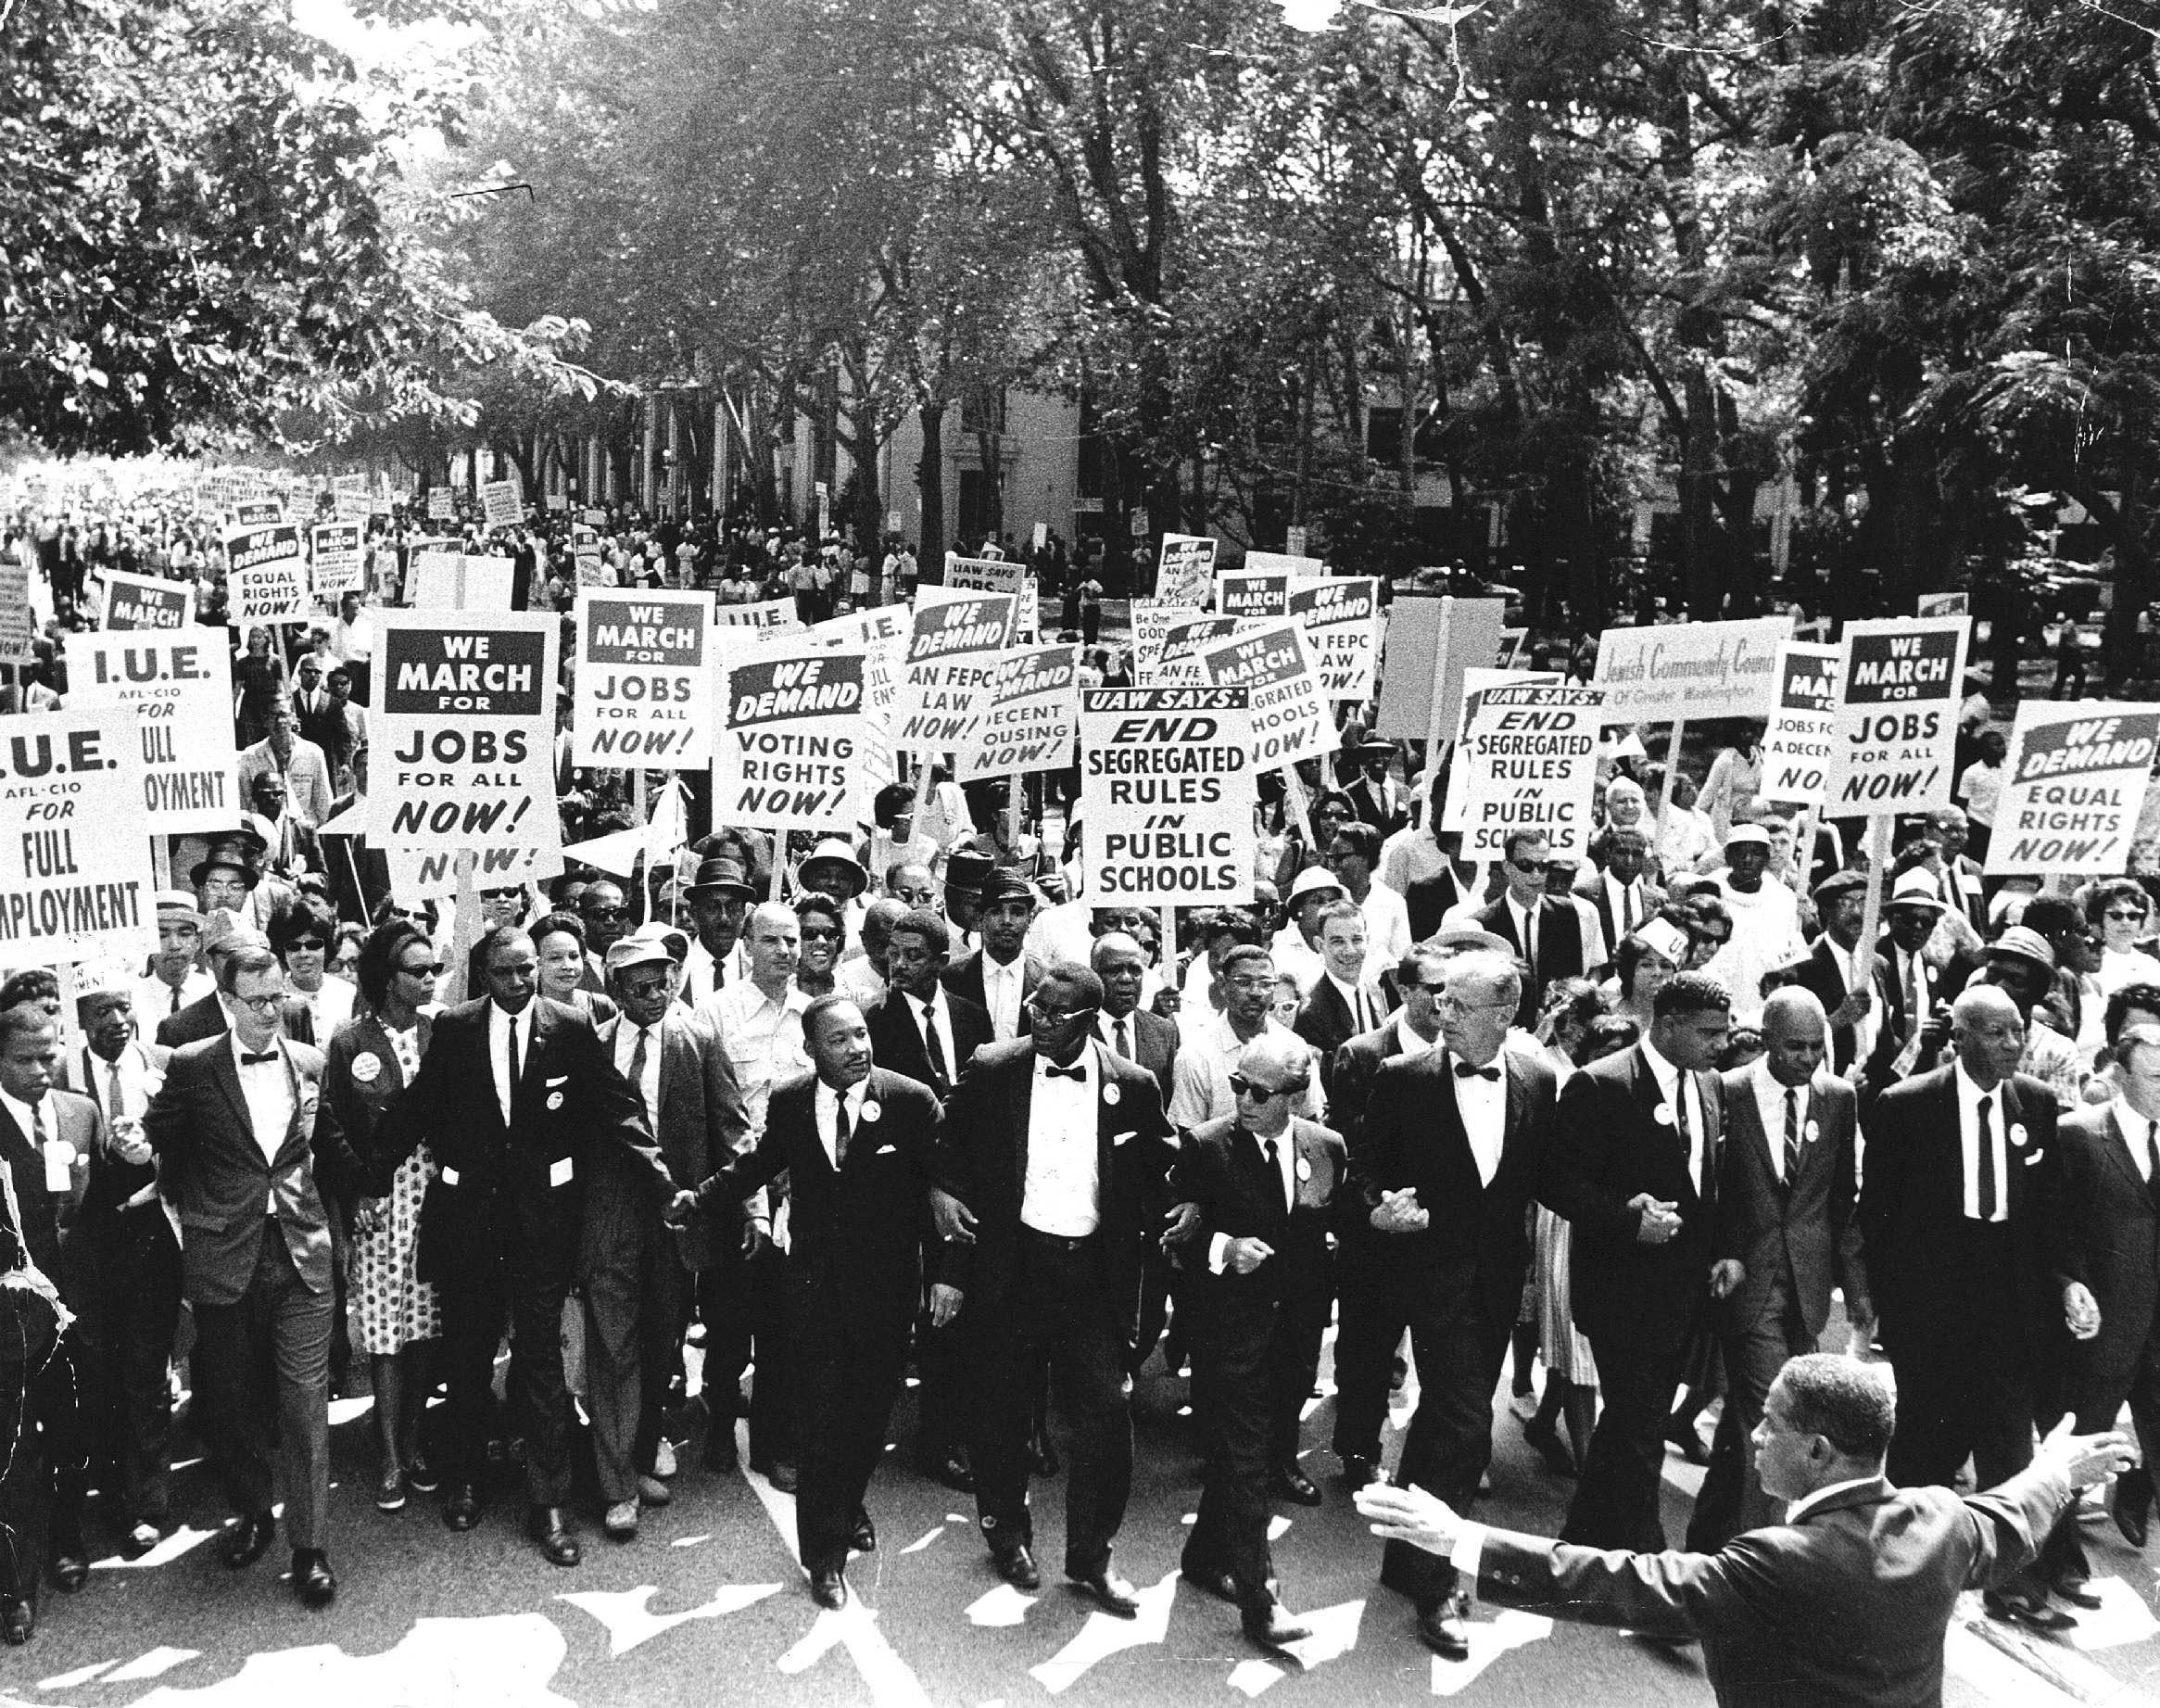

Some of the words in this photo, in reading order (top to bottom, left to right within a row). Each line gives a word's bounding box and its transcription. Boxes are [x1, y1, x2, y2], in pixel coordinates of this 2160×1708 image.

[249, 530, 276, 549] WE
[233, 538, 299, 570] DEMAND
[242, 571, 297, 586] EQUAL
[953, 563, 983, 575] UAW
[985, 567, 1016, 579] SAYS
[242, 586, 299, 601] RIGHTS
[319, 576, 357, 590] NOW!
[1245, 578, 1268, 591] WE
[140, 588, 165, 607] WE
[1226, 591, 1284, 608] MARCH
[1314, 585, 1347, 607] WE
[114, 601, 181, 627] MARCH
[243, 599, 301, 617] NOW!
[628, 605, 664, 625] WE
[943, 601, 982, 628] WE
[1244, 607, 1267, 616] FOR
[1305, 597, 1370, 627] EMAND
[595, 623, 695, 649] MARCH
[914, 620, 1003, 658] DEMAND
[1186, 622, 1217, 640] WE
[1307, 635, 1320, 650] N
[1326, 634, 1370, 649] FEPC
[0, 639, 28, 656] OW!
[443, 636, 490, 660] WE
[625, 650, 665, 664] FOR
[1235, 639, 1267, 660] WE
[1889, 636, 1923, 658] WE
[95, 645, 211, 684] I.U.E.
[998, 654, 1041, 682] WE
[1157, 664, 1181, 678] AN
[1185, 664, 1201, 678] FE
[1217, 646, 1297, 686] MARCH
[1320, 653, 1354, 667] AW
[1821, 659, 1839, 677] W
[1854, 656, 1949, 686] MARCH
[397, 661, 533, 693] MARCH
[771, 659, 825, 689] WE
[907, 665, 940, 687] AN
[945, 665, 994, 689] FEPC
[118, 688, 182, 700] AFL-CIO
[594, 675, 691, 702] JOBS
[1090, 690, 1156, 711] UAW
[1156, 688, 1246, 711] SAYS:
[1251, 678, 1313, 712] GRATED
[1485, 689, 1534, 705] UAW
[1882, 686, 1918, 701] FOR
[137, 702, 175, 718] FOR
[437, 695, 491, 711] FOR
[596, 706, 638, 719] FOR
[651, 707, 688, 720] ALL
[735, 681, 861, 722] DEMAND
[921, 691, 973, 712] LAW
[985, 703, 1063, 727] ECENT
[1251, 700, 1320, 734] HOOLS
[1496, 711, 1577, 731] END
[1775, 717, 1814, 734] JOBS
[1819, 721, 1834, 735] FO
[903, 714, 979, 740] NOW!
[982, 724, 1068, 747] OUSING
[1110, 716, 1219, 744] END
[1848, 711, 1940, 744] JOBS
[2065, 717, 2123, 747] WE
[141, 725, 177, 765] ULL
[394, 728, 529, 765] JOBS
[591, 726, 695, 756] NOW!
[736, 731, 854, 761] VOTING
[1476, 734, 1593, 756] SEGREGATED
[1772, 740, 1784, 754] A
[1787, 741, 1832, 757] DECEN
[0, 729, 118, 778] .U.E.
[973, 738, 1064, 770] NOW!
[1087, 745, 1245, 777] SEGREGATED
[1850, 749, 1888, 764] FOR
[1900, 747, 1933, 760] ALL
[2021, 737, 2154, 778] DEMAND
[398, 772, 455, 787] FOR
[472, 772, 523, 787] ALL
[742, 758, 847, 787] RIGHTS
[1490, 759, 1573, 780] RULES
[5, 781, 82, 800] AFL-CIO
[144, 770, 225, 812] OYMENT
[1110, 777, 1222, 804] RULES
[1513, 788, 1544, 799] IN
[1841, 764, 1939, 803] NOW!
[736, 785, 847, 817] NOW!
[2027, 785, 2123, 807] EQUAL
[26, 799, 76, 821] FOR
[391, 794, 532, 835] NOW!
[1143, 814, 1186, 829] IN
[1482, 803, 1575, 823] PUBLIC
[2018, 810, 2122, 832] RIGHTS
[1105, 831, 1232, 860] PUBLIC
[1474, 828, 1575, 850] SCLS
[2009, 836, 2119, 863] NOW!
[21, 828, 79, 879] FULL
[1099, 864, 1238, 893] SCHOOLS
[0, 881, 140, 941] PLOYMENT
